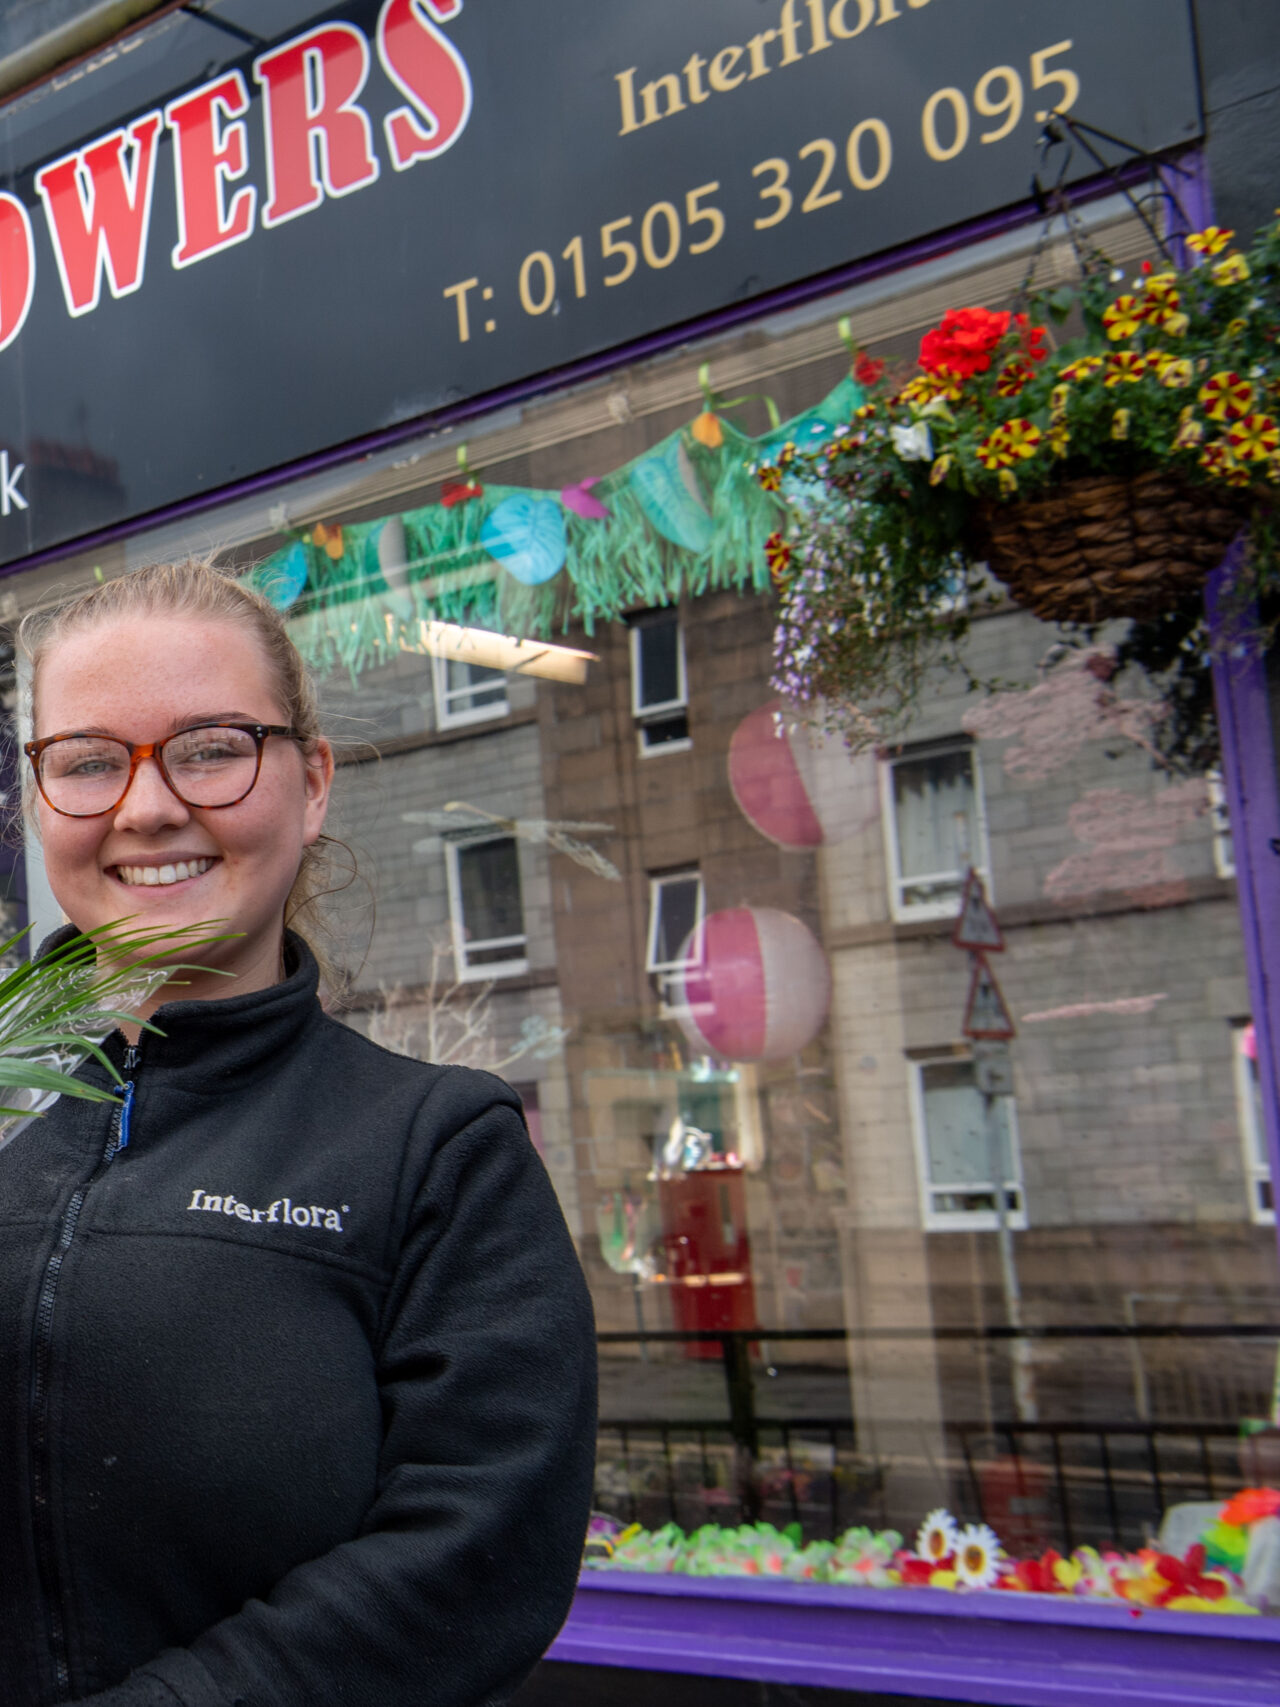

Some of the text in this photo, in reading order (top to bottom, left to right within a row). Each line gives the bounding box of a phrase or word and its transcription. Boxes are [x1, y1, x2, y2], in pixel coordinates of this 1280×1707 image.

[443, 39, 1080, 343] T: 01505 320 095
